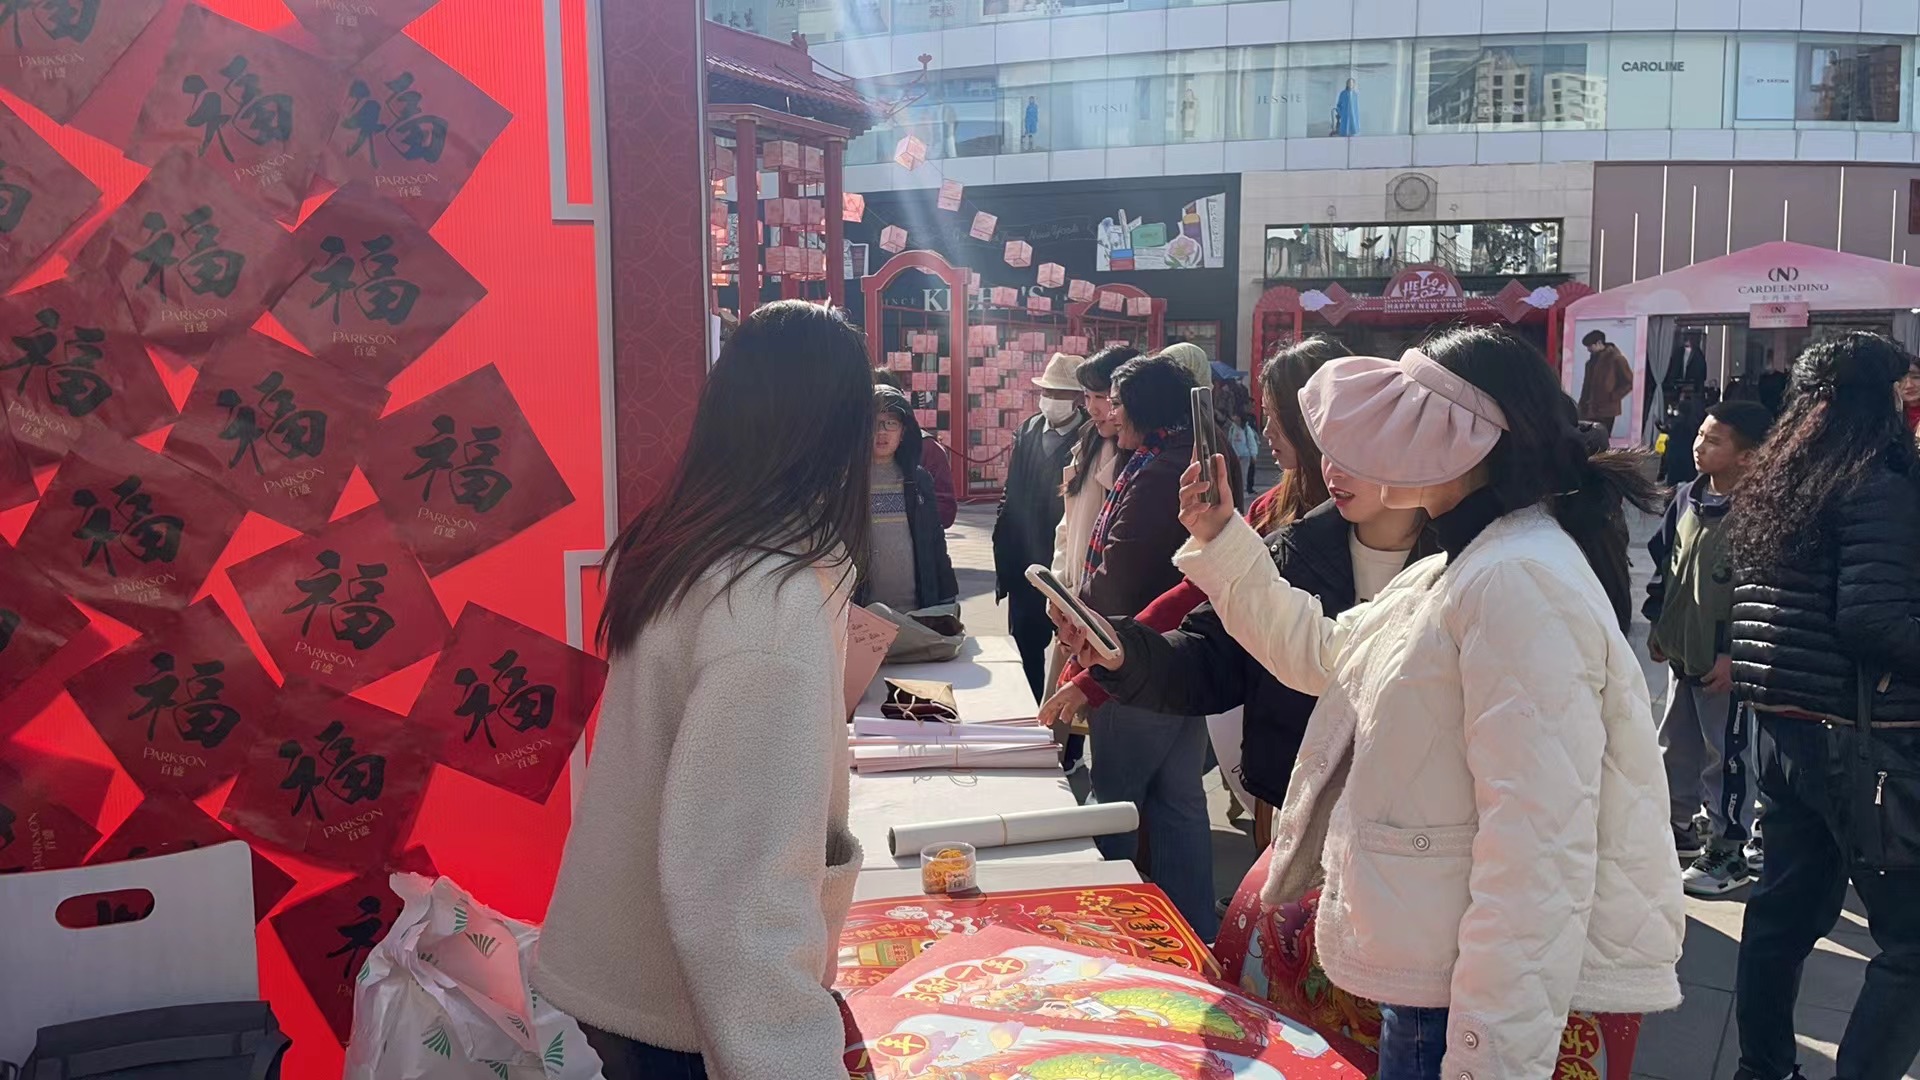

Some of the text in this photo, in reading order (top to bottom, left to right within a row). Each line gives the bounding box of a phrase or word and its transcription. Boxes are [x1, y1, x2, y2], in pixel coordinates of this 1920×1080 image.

[19, 54, 84, 67] PARKSON
[1621, 61, 1685, 72] CAROLINE
[182, 55, 293, 163] 福
[341, 72, 448, 169] 福
[234, 152, 296, 181] PARKSON
[375, 172, 438, 187] PARKSON
[133, 205, 246, 303] 福
[309, 234, 420, 325] 福
[1402, 278, 1439, 299] HELLO
[1410, 284, 1446, 302] 2024
[1738, 283, 1829, 294] CARDEENDINO
[161, 308, 228, 321] PARKSON
[333, 331, 398, 345] PARKSON
[0, 308, 112, 417] 福
[217, 371, 328, 476] 福
[403, 415, 512, 512] 福
[263, 467, 325, 493] PARKSON
[72, 474, 184, 577] 福
[418, 507, 478, 532] PARKSON
[282, 550, 395, 650] 福
[295, 642, 356, 667] PARKSON
[128, 652, 241, 748] 福
[454, 650, 557, 748] 福
[143, 747, 207, 767] PARKSON
[494, 739, 551, 765] PARKSON
[279, 721, 386, 821] 福
[323, 809, 384, 839] PARKSON
